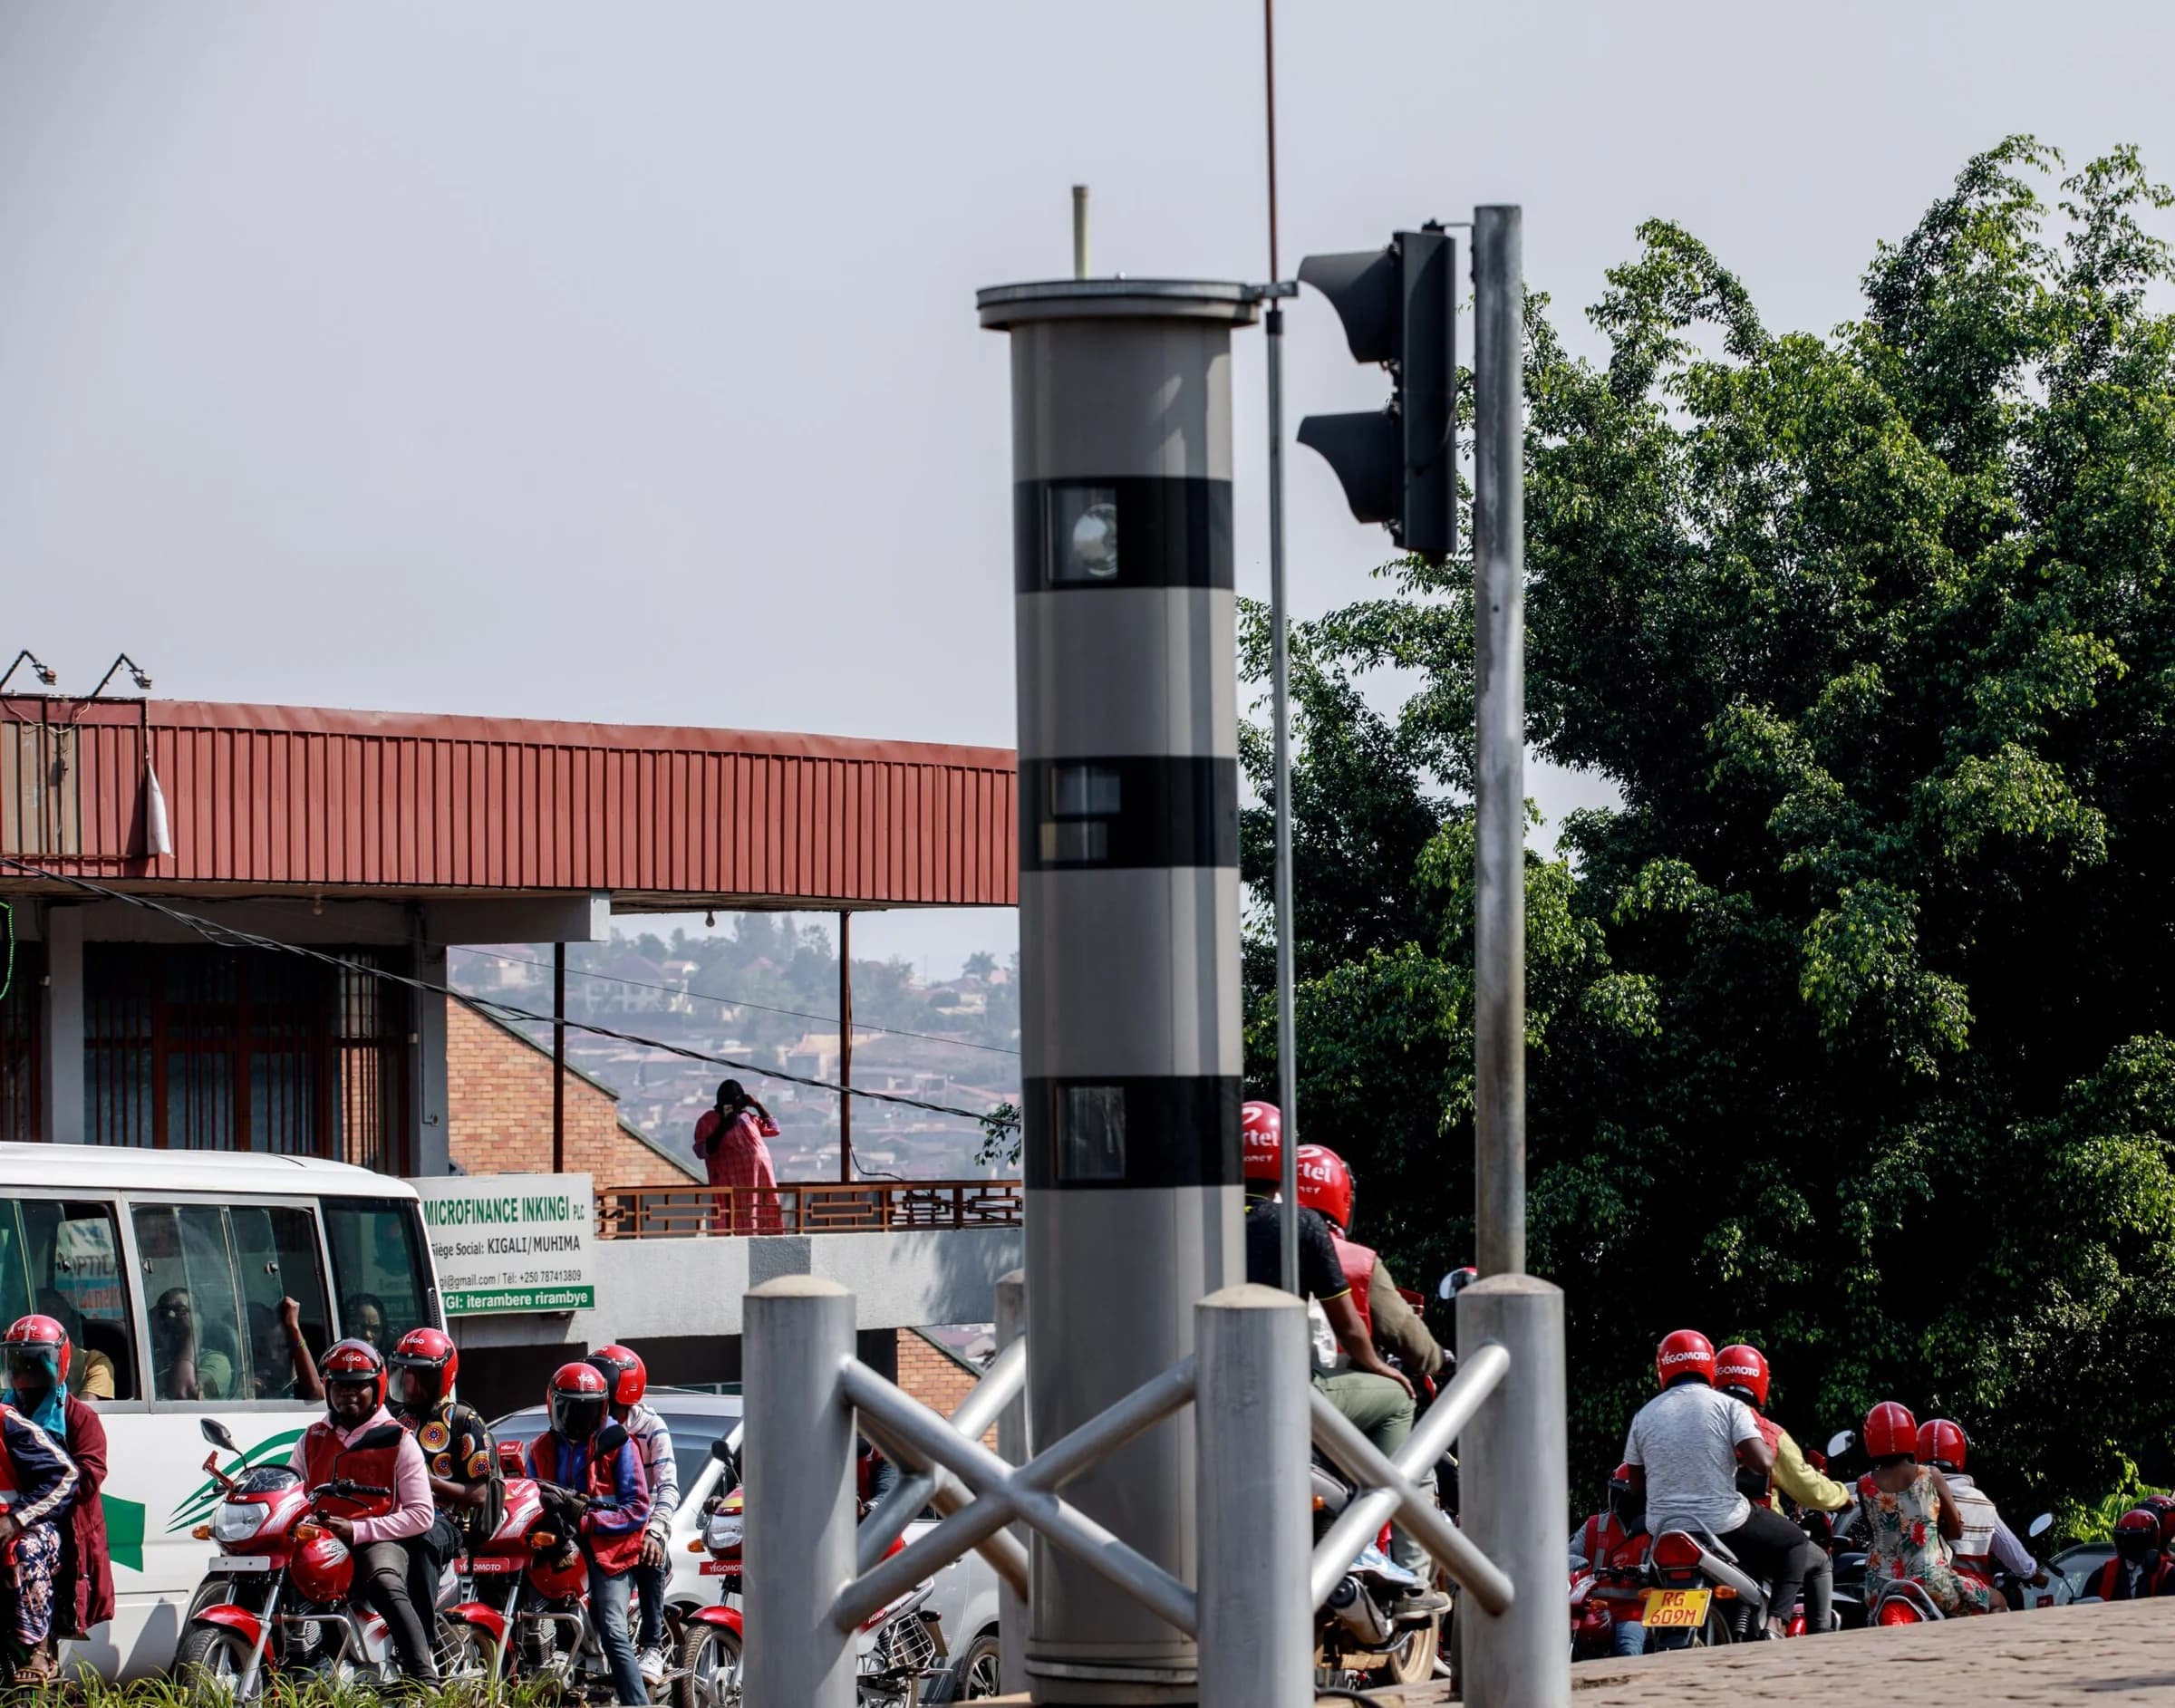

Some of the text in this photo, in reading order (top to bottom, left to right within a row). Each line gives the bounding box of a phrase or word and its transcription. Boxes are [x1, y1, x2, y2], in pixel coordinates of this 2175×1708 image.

[1242, 1129, 1280, 1147] rtel
[423, 1196, 585, 1226] MICROFINANCE INKINGI PLC
[456, 1241, 485, 1256] Social:
[488, 1235, 581, 1256] KIGALI/MUHIMA
[439, 1274, 497, 1290] gi@gmail.com
[502, 1271, 517, 1284] Tél:
[520, 1271, 538, 1283] +250
[541, 1269, 582, 1282] 787413809
[467, 1292, 532, 1309] iterambere
[535, 1290, 588, 1307] rirambye
[1715, 1363, 1760, 1377] ÉGOMOTO
[459, 1558, 501, 1572] YÉOMOTO
[709, 1561, 743, 1573] YÉGOMOT
[1661, 1591, 1686, 1607] RG
[1649, 1609, 1697, 1625] 609M
